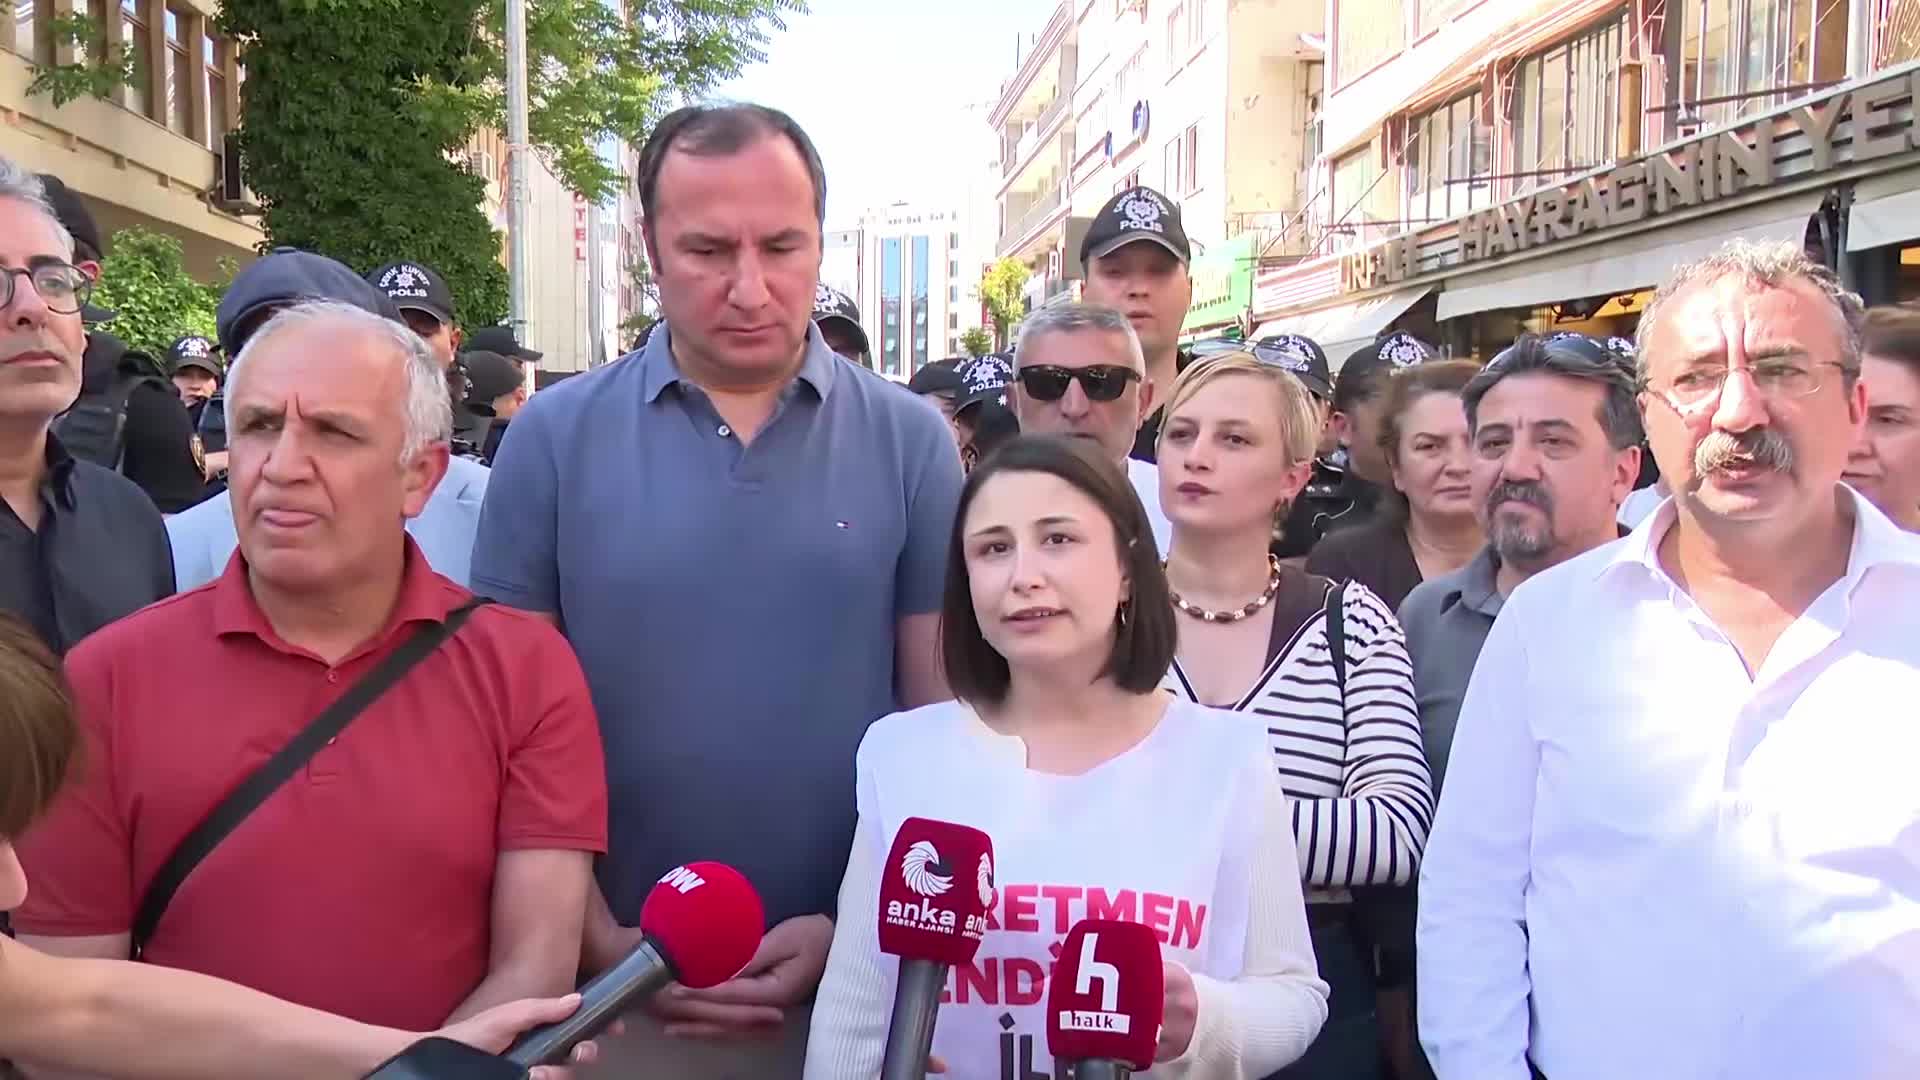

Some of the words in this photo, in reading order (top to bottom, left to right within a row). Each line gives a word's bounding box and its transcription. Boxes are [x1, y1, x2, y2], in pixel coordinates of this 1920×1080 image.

[657, 865, 706, 894] OW
[887, 898, 956, 928] anka
[1072, 1011, 1113, 1029] halk
